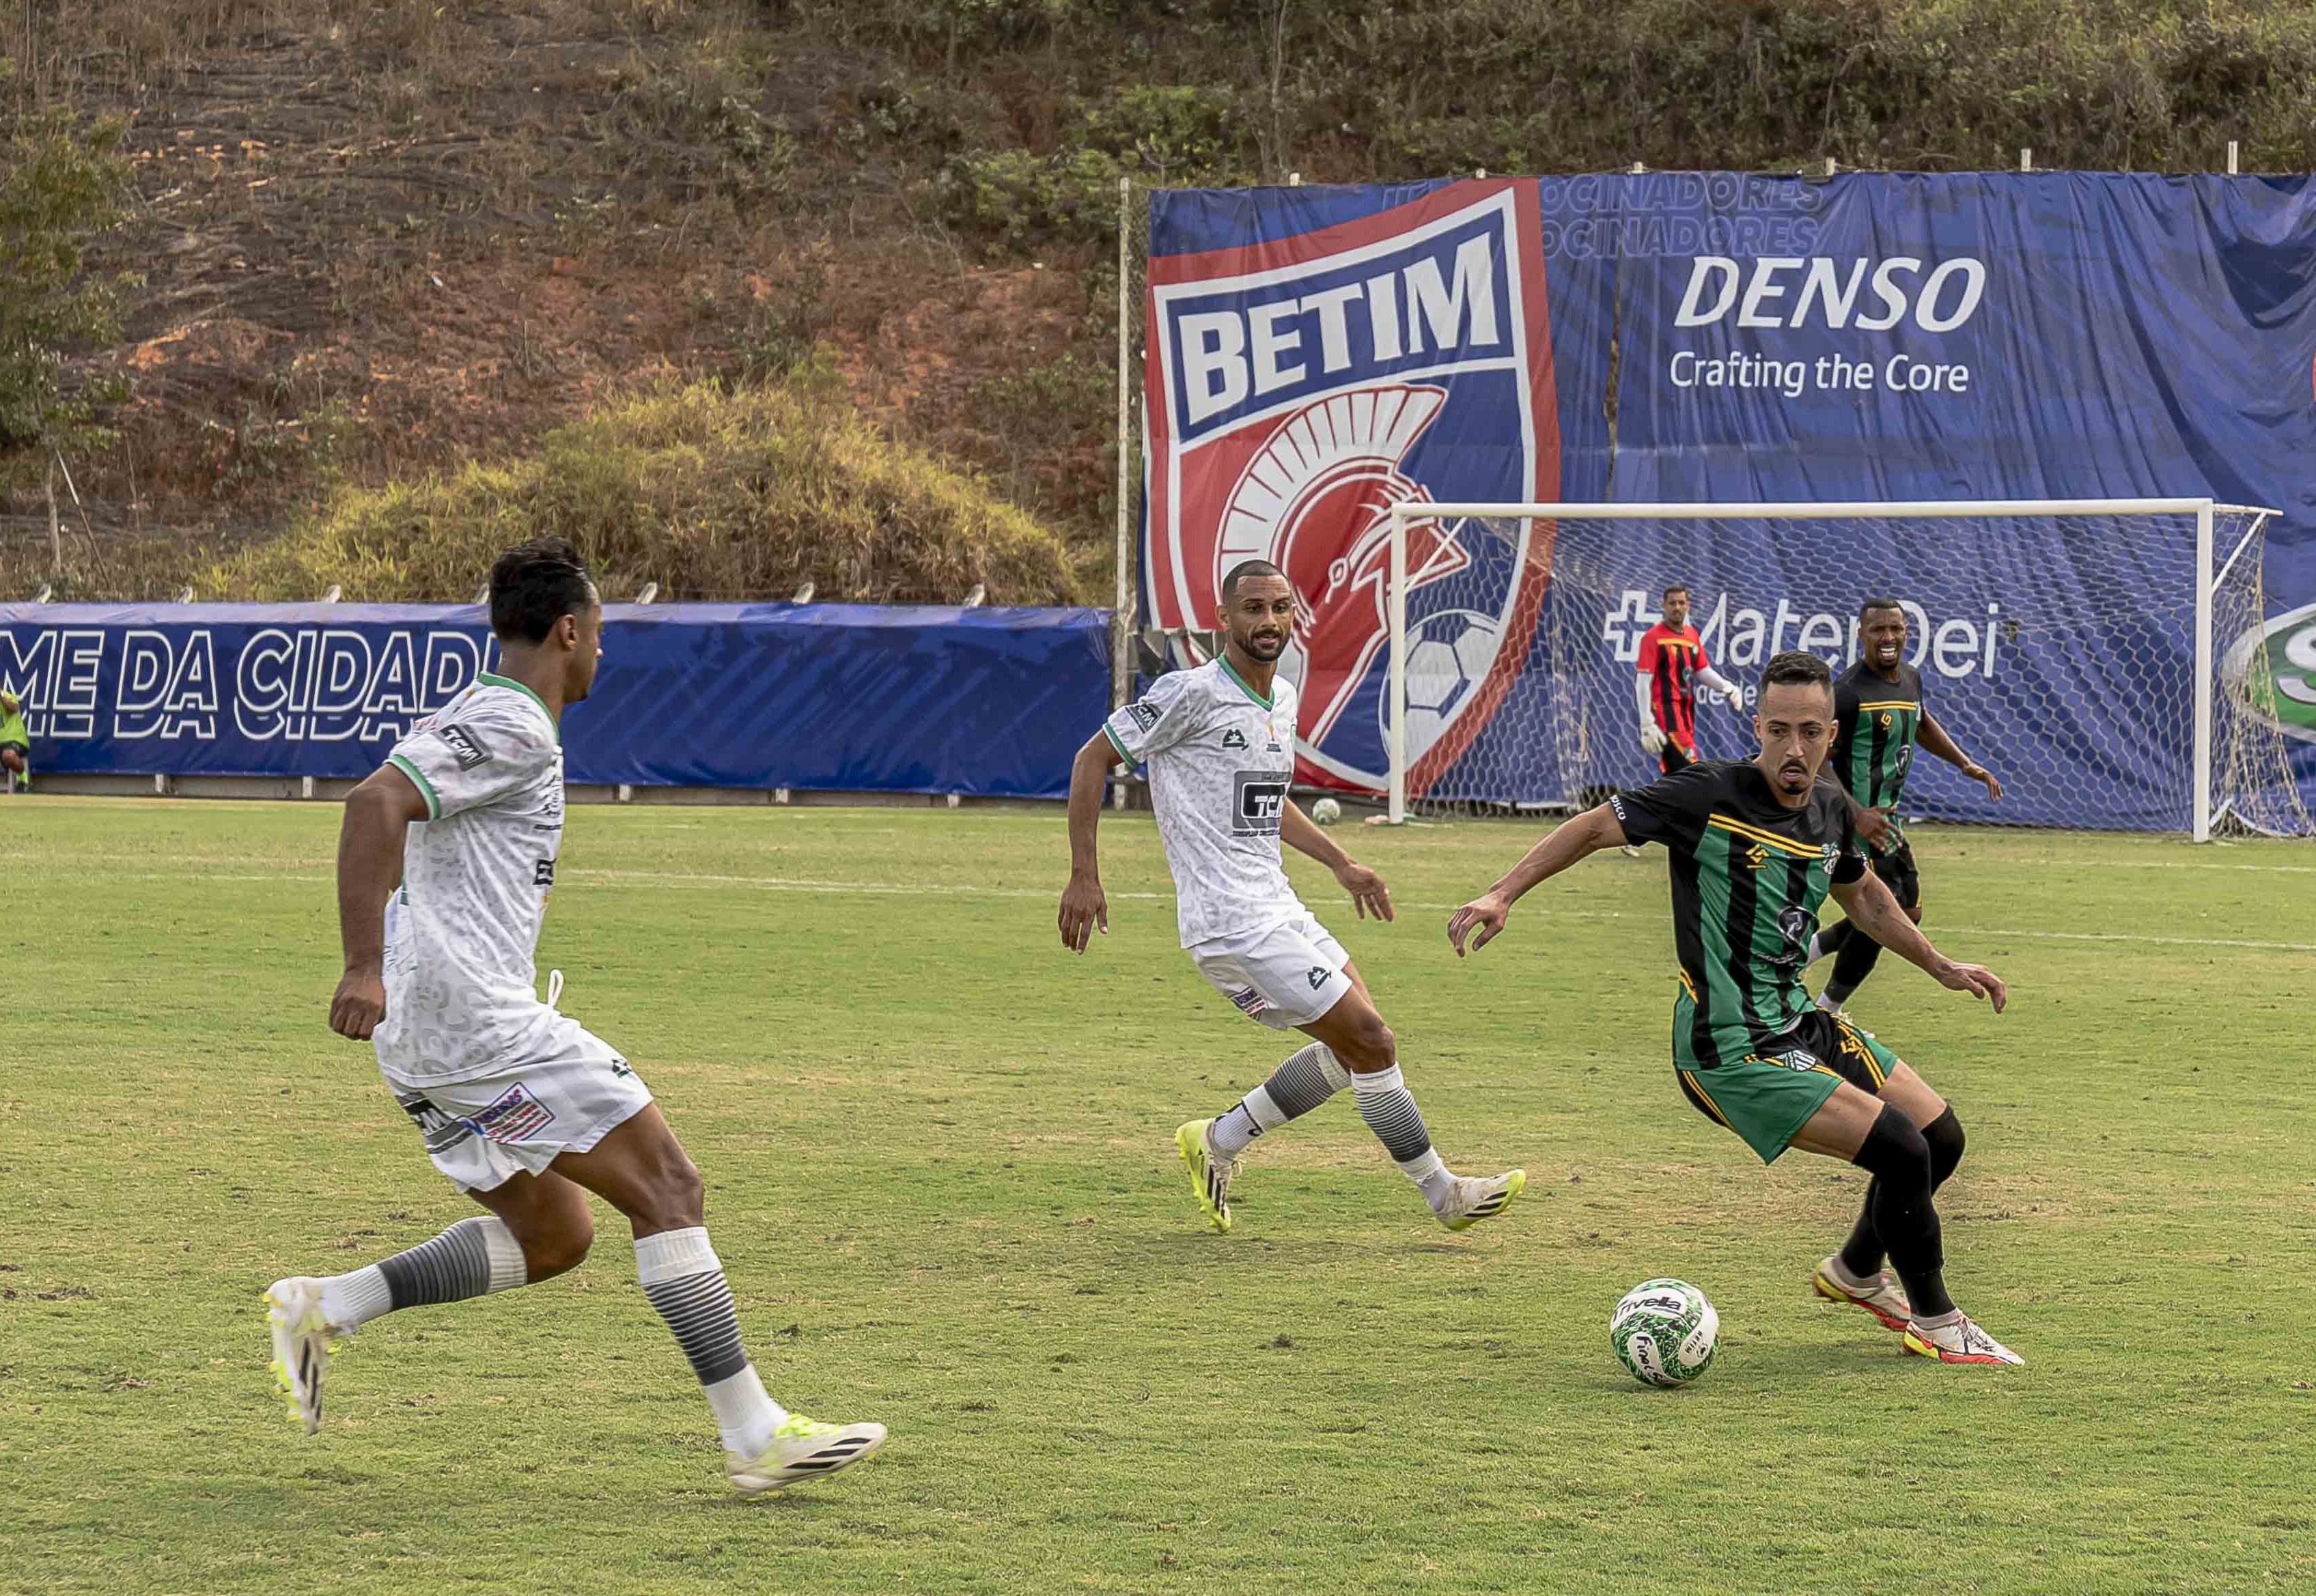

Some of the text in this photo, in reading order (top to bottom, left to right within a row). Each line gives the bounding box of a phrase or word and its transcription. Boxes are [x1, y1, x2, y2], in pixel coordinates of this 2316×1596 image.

[1178, 232, 1500, 426] BETIM
[1674, 256, 1986, 332] DENSO
[1670, 351, 1969, 398] Crafting the Core
[115, 630, 219, 711] DA
